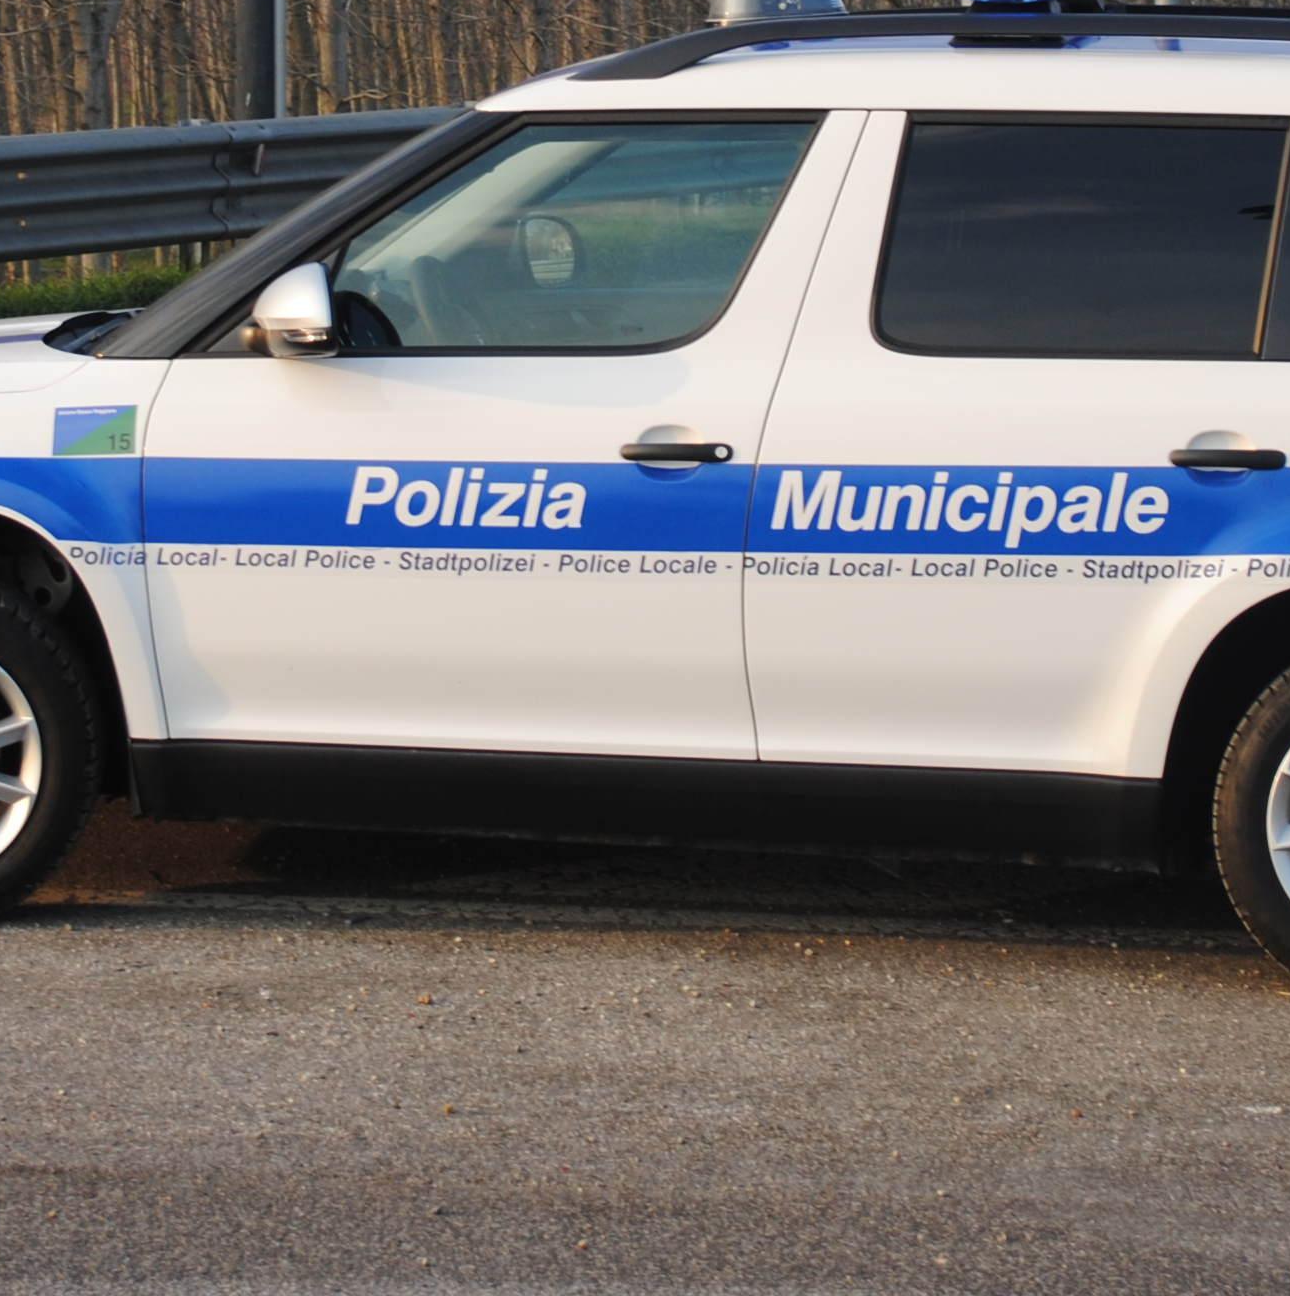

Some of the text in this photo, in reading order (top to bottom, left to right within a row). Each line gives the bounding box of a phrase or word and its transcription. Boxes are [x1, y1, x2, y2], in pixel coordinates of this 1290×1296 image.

[108, 432, 131, 451] 15
[345, 466, 1169, 549] Polizia Municipale
[235, 548, 296, 567] Local
[305, 550, 376, 570] Police
[399, 551, 535, 576] Stadtpolizei
[558, 554, 631, 574] Police
[639, 555, 717, 574] Locale
[743, 555, 819, 576] Policía
[911, 558, 975, 577] Local
[984, 558, 1058, 578] Police
[1082, 559, 1226, 584] Stadtpolizei
